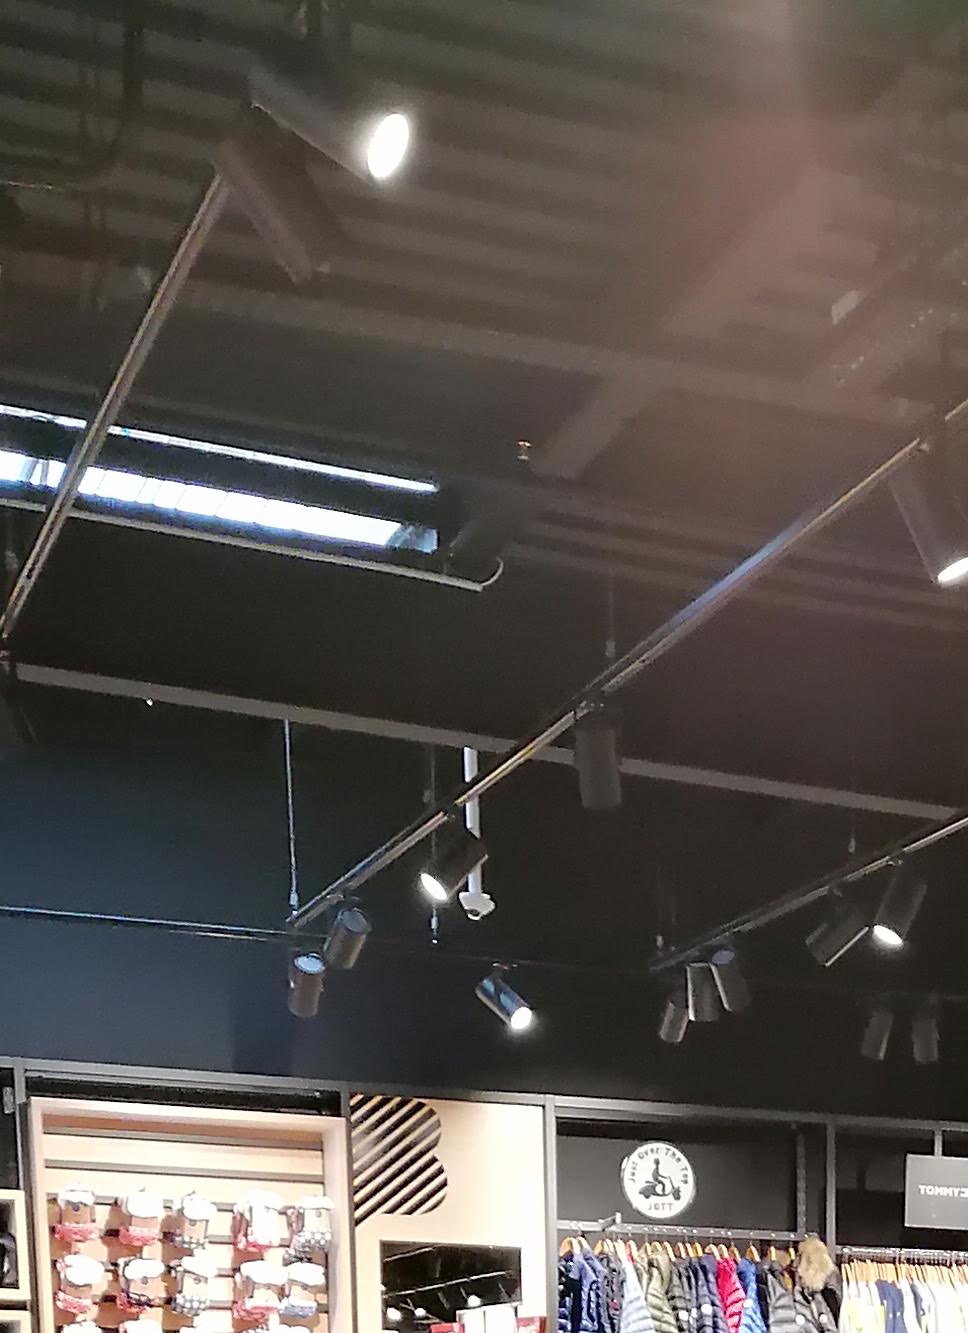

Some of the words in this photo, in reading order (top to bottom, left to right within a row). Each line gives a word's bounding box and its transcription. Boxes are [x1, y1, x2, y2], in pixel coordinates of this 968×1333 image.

[638, 1147, 660, 1159] Over
[665, 1147, 681, 1162] The
[918, 1184, 961, 1198] TOMMY
[648, 1202, 673, 1211] JOTT
